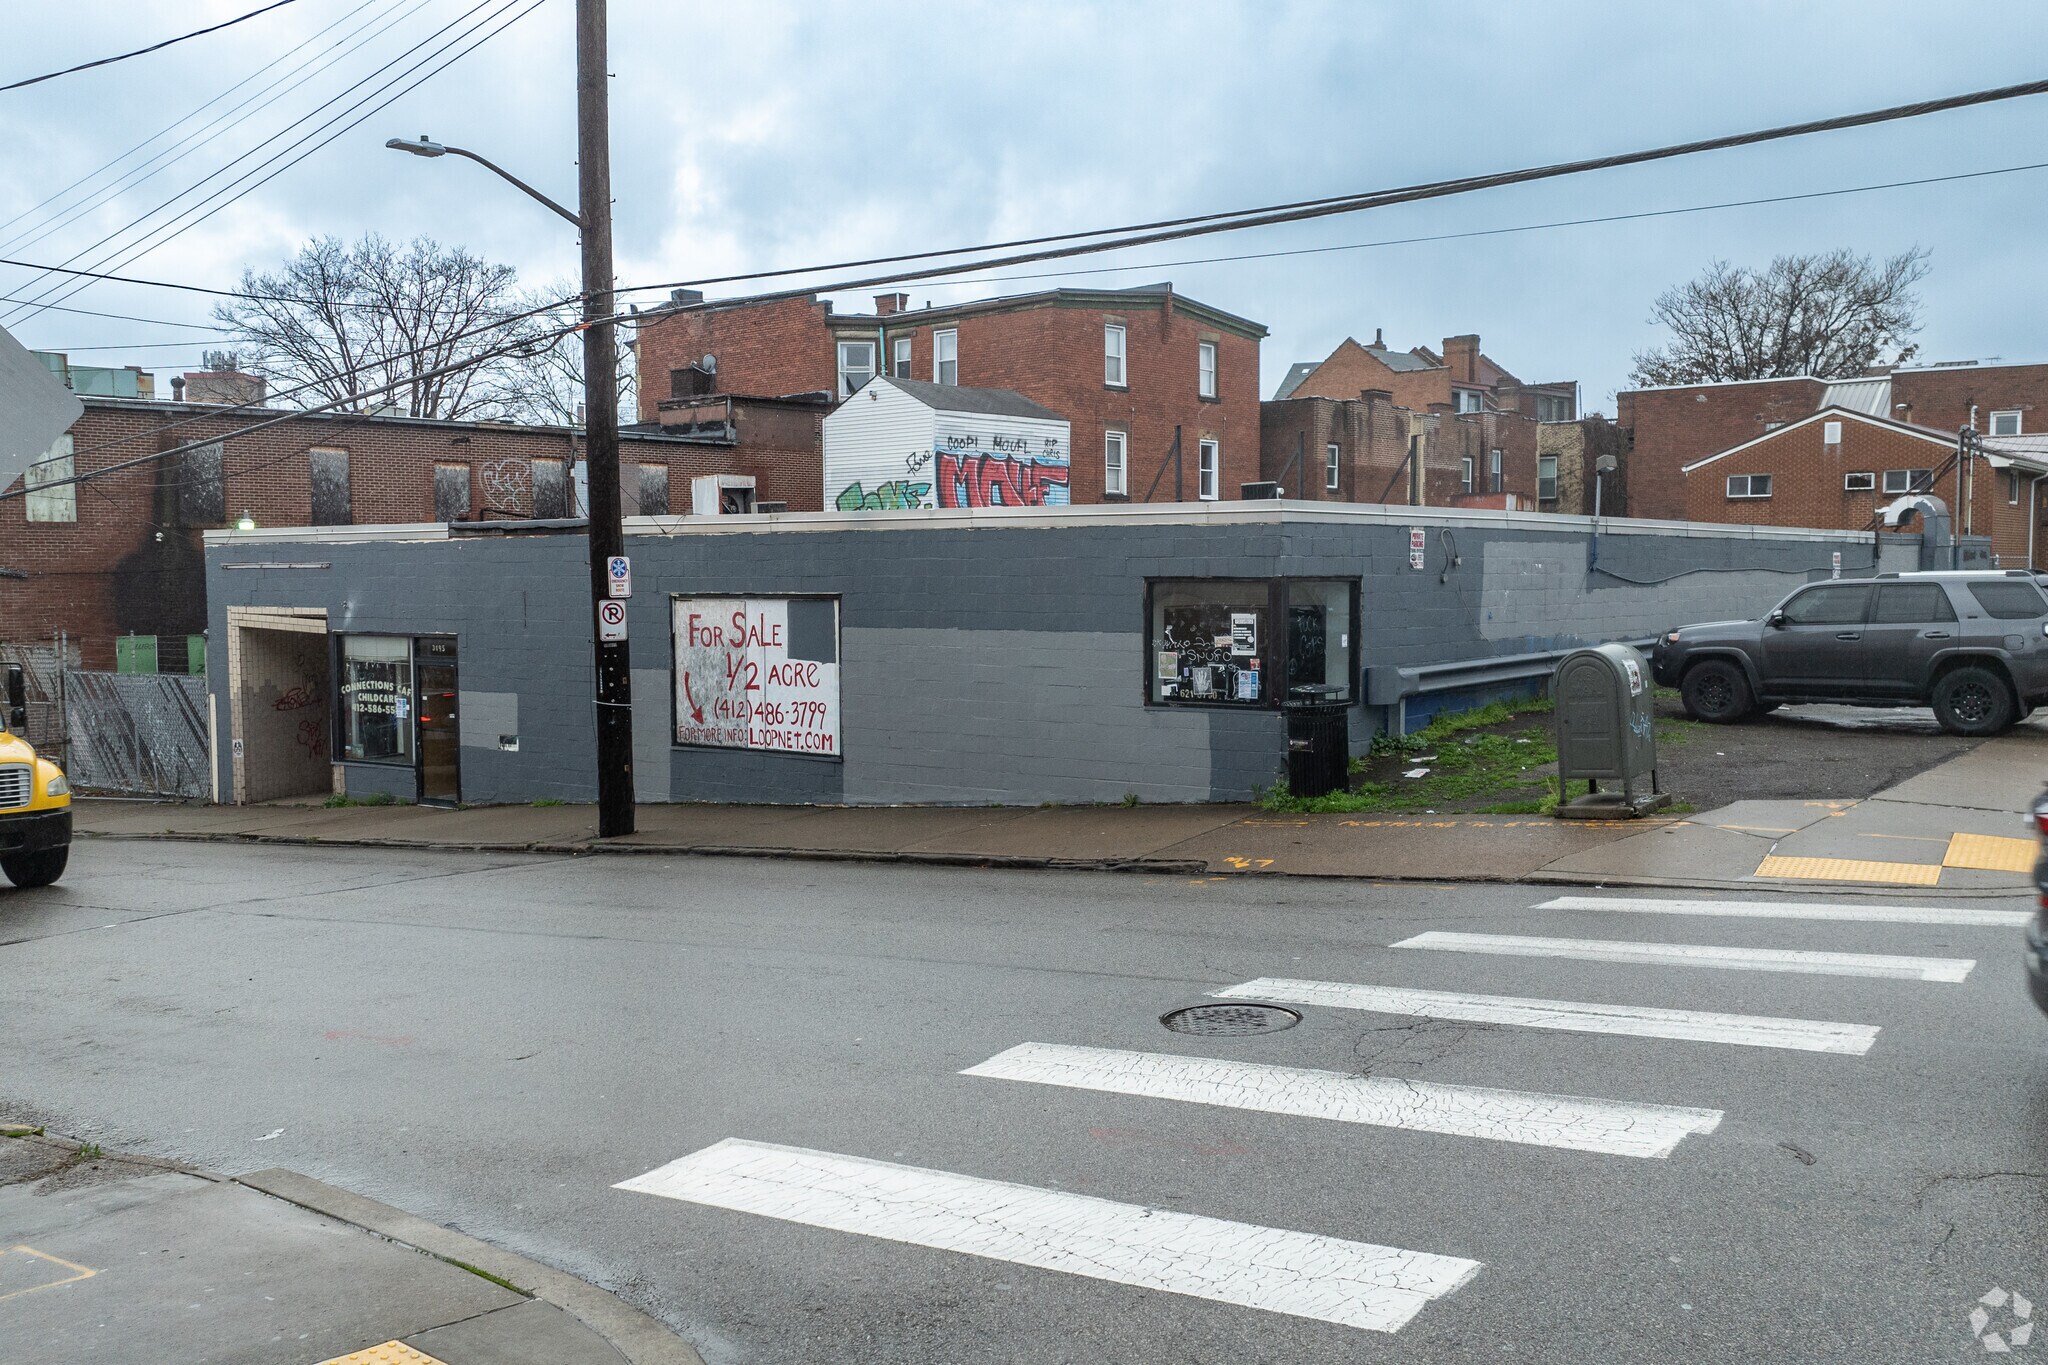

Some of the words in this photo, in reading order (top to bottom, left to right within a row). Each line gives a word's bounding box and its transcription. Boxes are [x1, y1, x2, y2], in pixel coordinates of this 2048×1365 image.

[689, 613, 724, 648] FOR
[729, 611, 783, 648] SALE
[725, 651, 760, 691] 1/2
[341, 680, 394, 694] CONNECTIONS
[397, 685, 413, 697] CAF
[351, 703, 397, 714] 412-586-55
